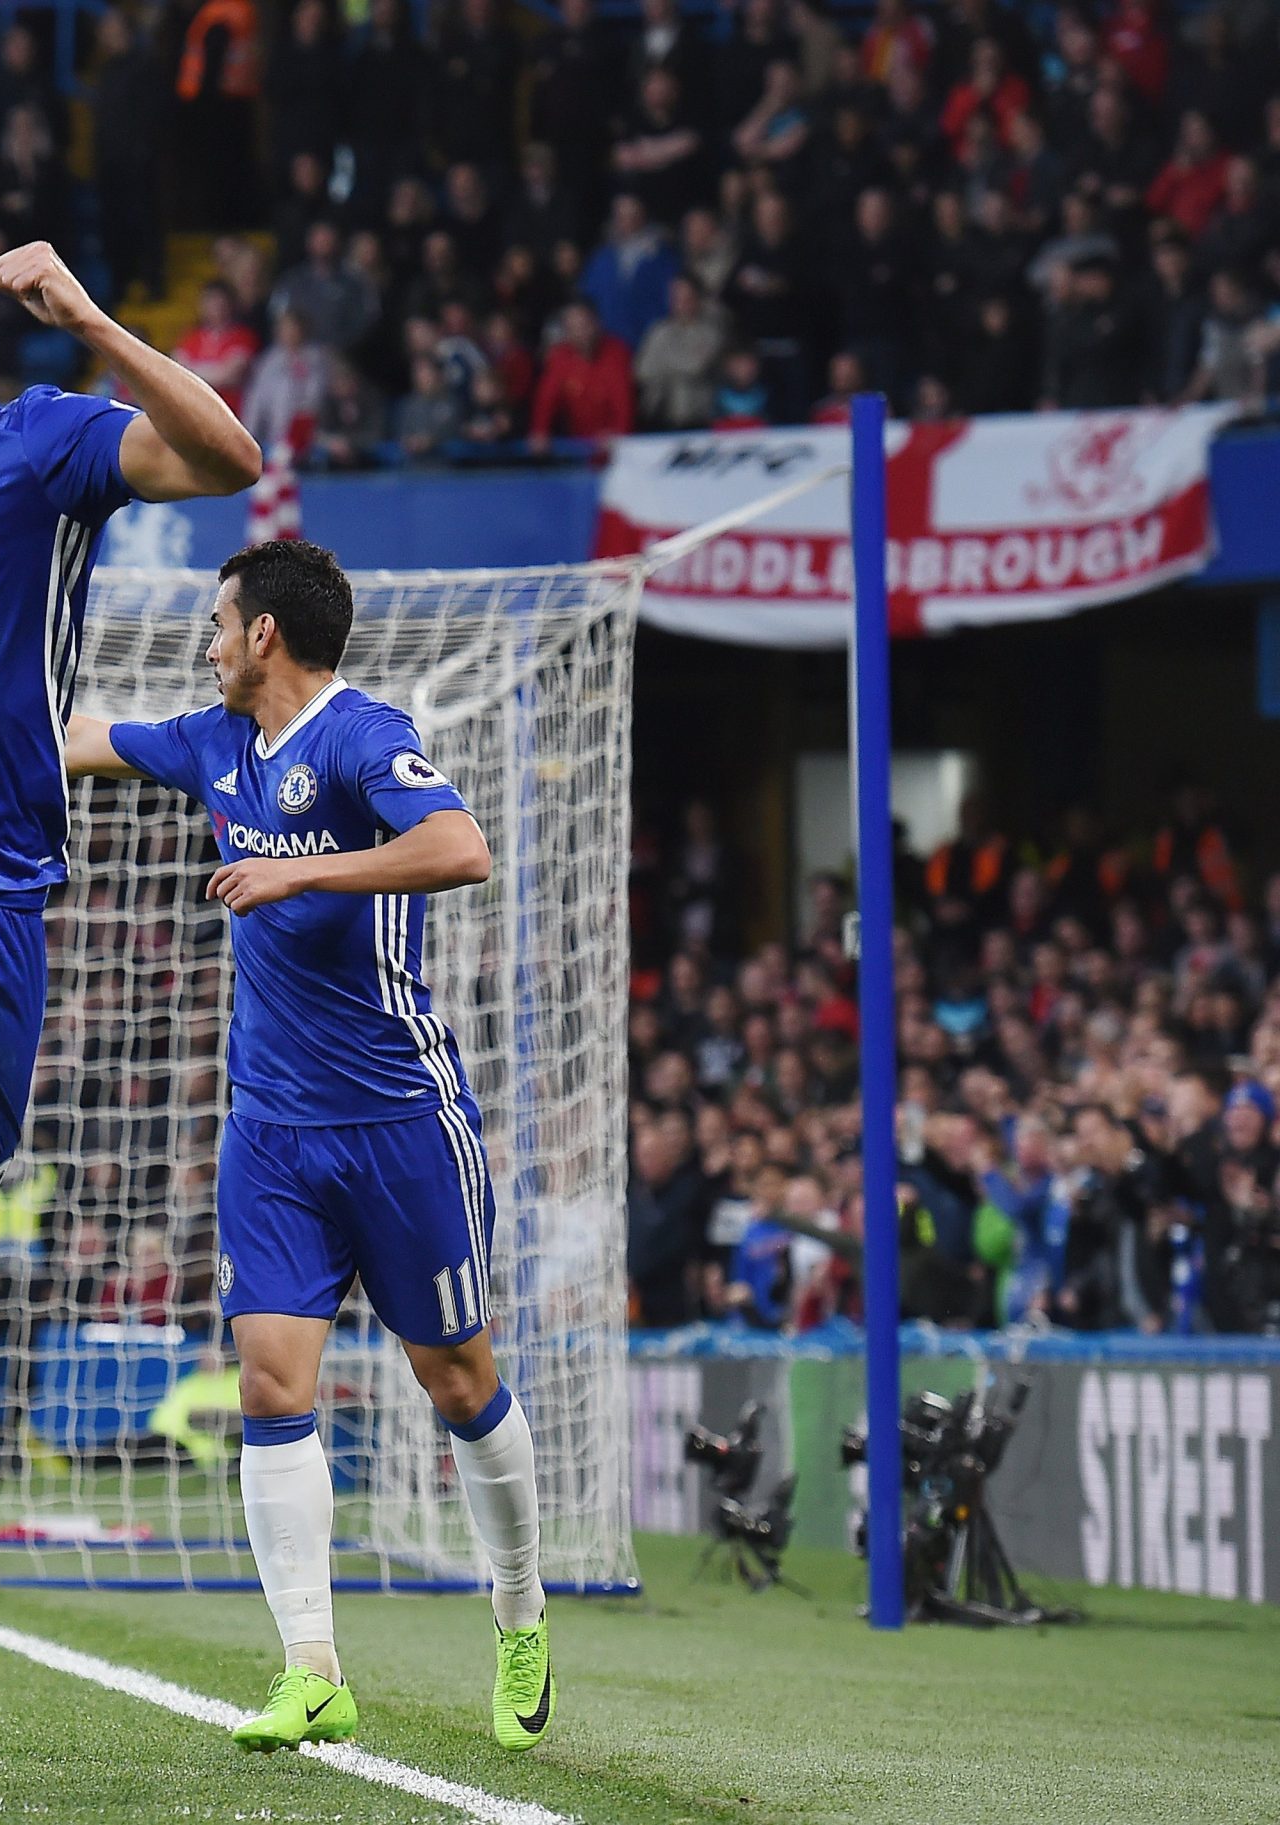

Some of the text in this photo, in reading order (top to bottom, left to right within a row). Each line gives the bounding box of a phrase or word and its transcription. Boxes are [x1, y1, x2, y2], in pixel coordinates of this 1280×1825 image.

[227, 821, 340, 858] YOKOHAMA
[432, 1256, 479, 1337] 11
[1078, 1368, 1272, 1604] STREET
